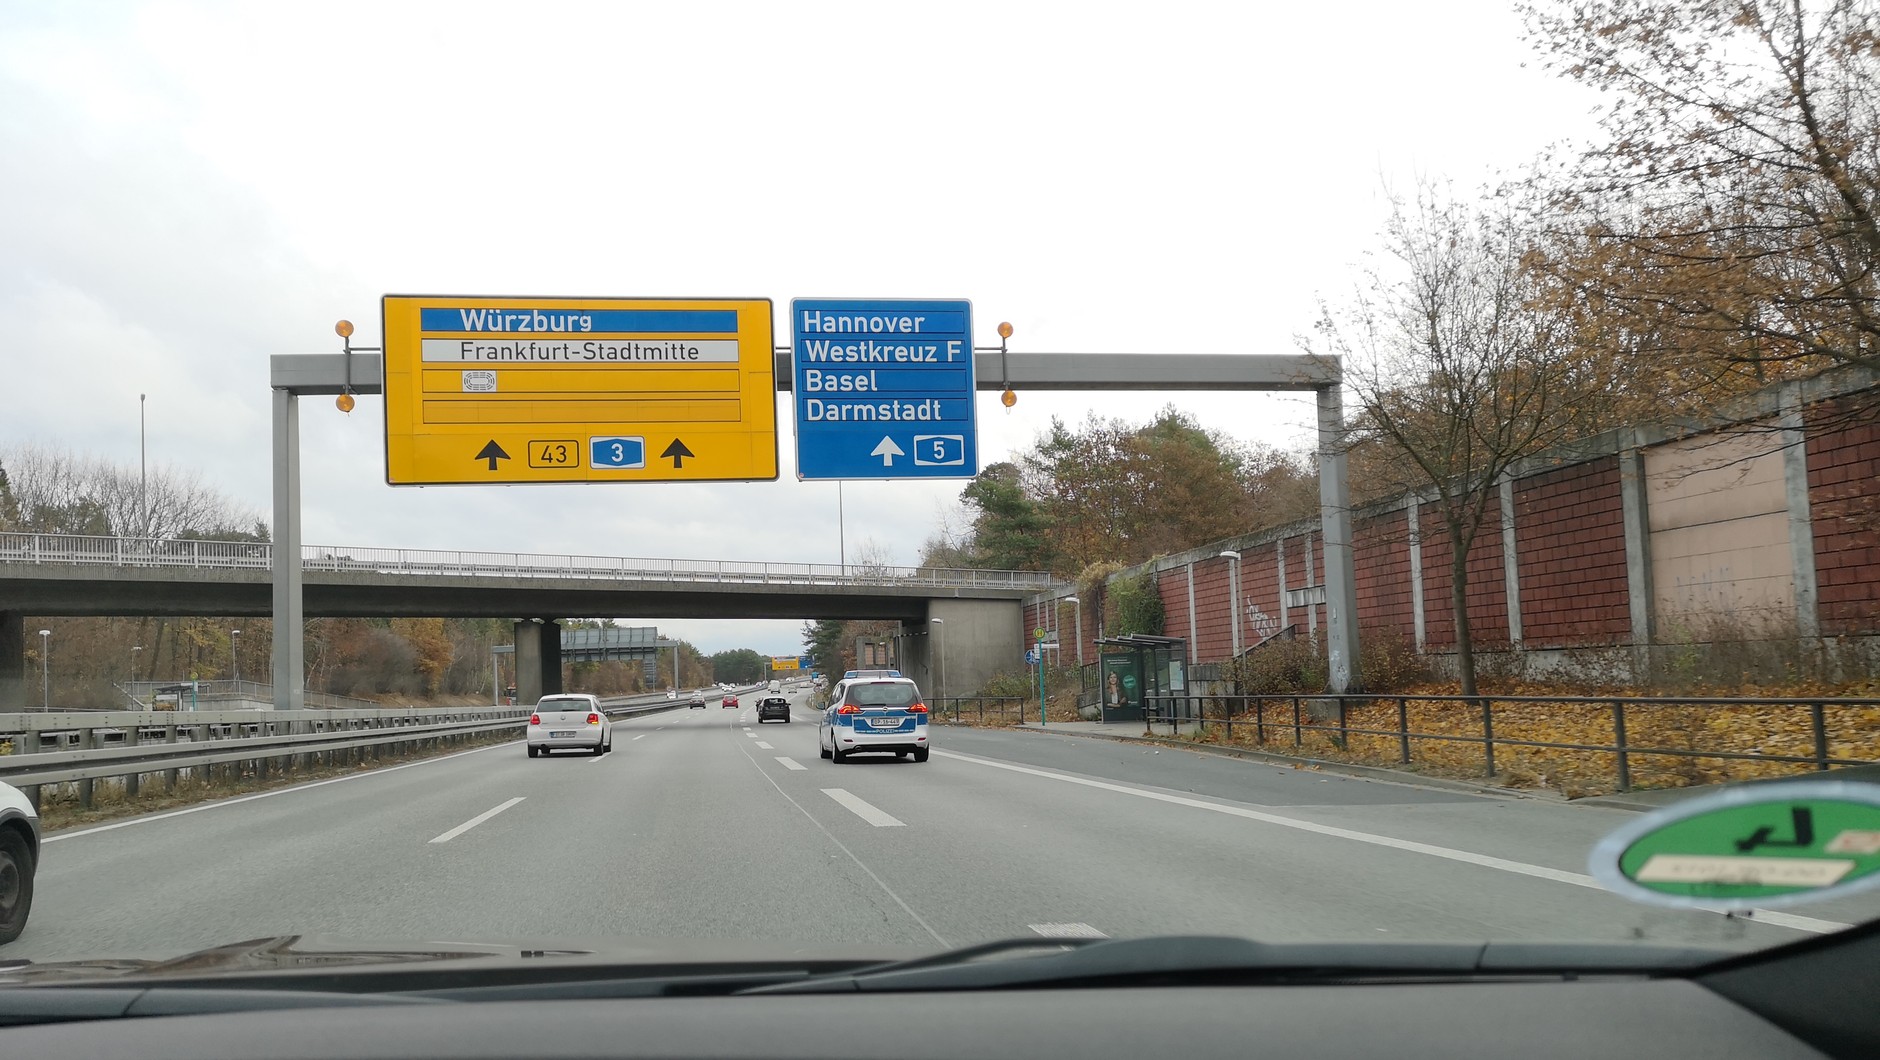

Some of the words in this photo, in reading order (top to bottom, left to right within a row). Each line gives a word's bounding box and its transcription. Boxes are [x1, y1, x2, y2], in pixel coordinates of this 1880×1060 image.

[460, 308, 592, 332] Würzburg
[803, 310, 926, 333] Hannover
[460, 341, 699, 361] Frankfurt-Stadtmitte
[805, 340, 938, 362] Westkreuz
[947, 340, 962, 362] F
[805, 369, 878, 392] Basel
[806, 398, 942, 421] Darmstadt
[540, 444, 567, 463] 43
[611, 442, 624, 463] 3
[933, 440, 945, 460] 5
